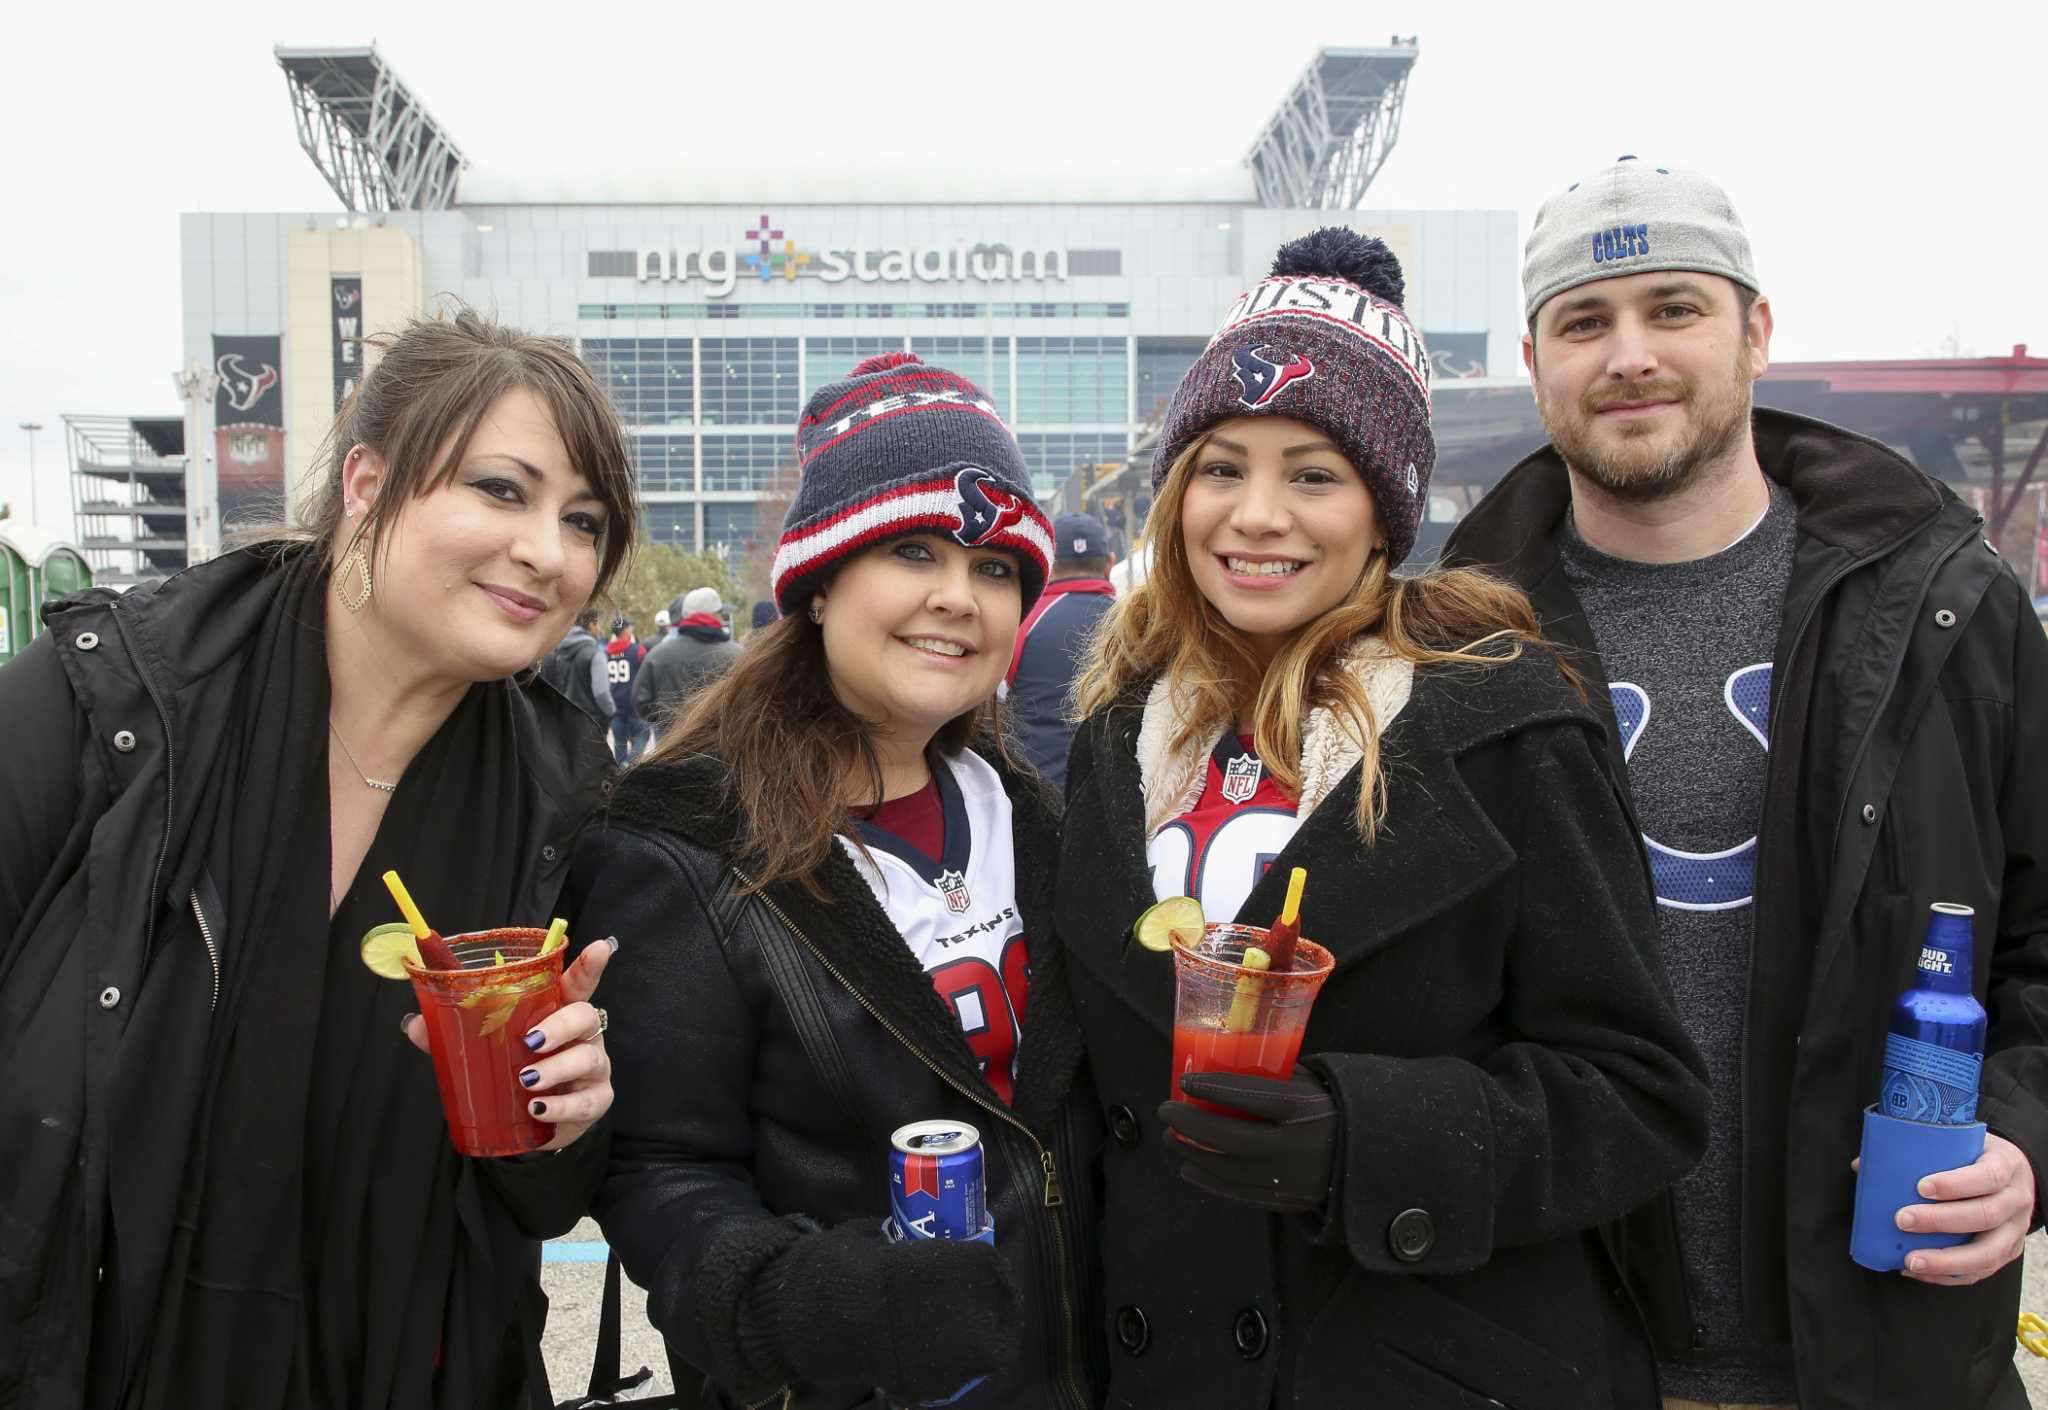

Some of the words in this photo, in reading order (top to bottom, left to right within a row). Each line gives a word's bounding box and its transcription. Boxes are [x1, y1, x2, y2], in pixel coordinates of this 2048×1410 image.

[1592, 224, 1649, 263] COLTS
[637, 246, 737, 298] nrg
[818, 236, 1068, 282] stadium
[608, 660, 630, 683] 99
[1228, 775, 1251, 796] NFL
[947, 889, 969, 909] NFL
[1921, 948, 1948, 962] BUD
